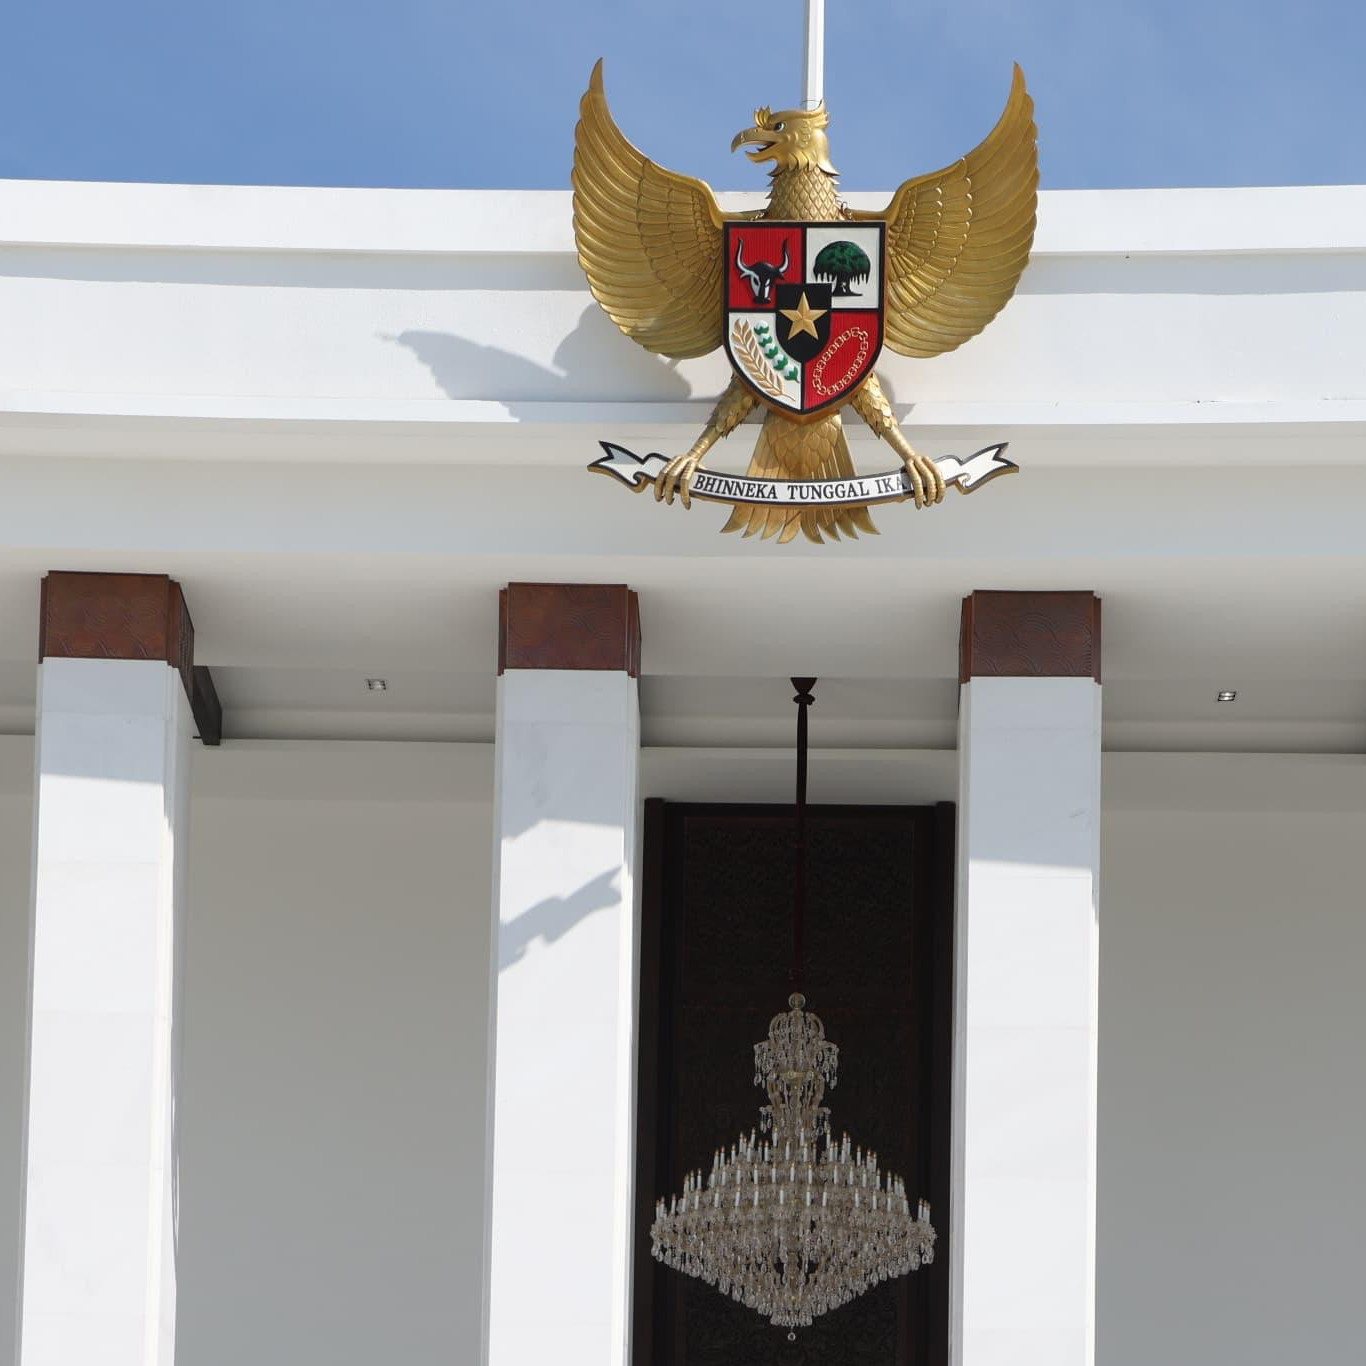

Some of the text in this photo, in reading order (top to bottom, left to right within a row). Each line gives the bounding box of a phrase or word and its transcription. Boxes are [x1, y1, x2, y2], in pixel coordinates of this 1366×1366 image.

[693, 475, 907, 500] BHINNEKA TUNGGAL IKA
